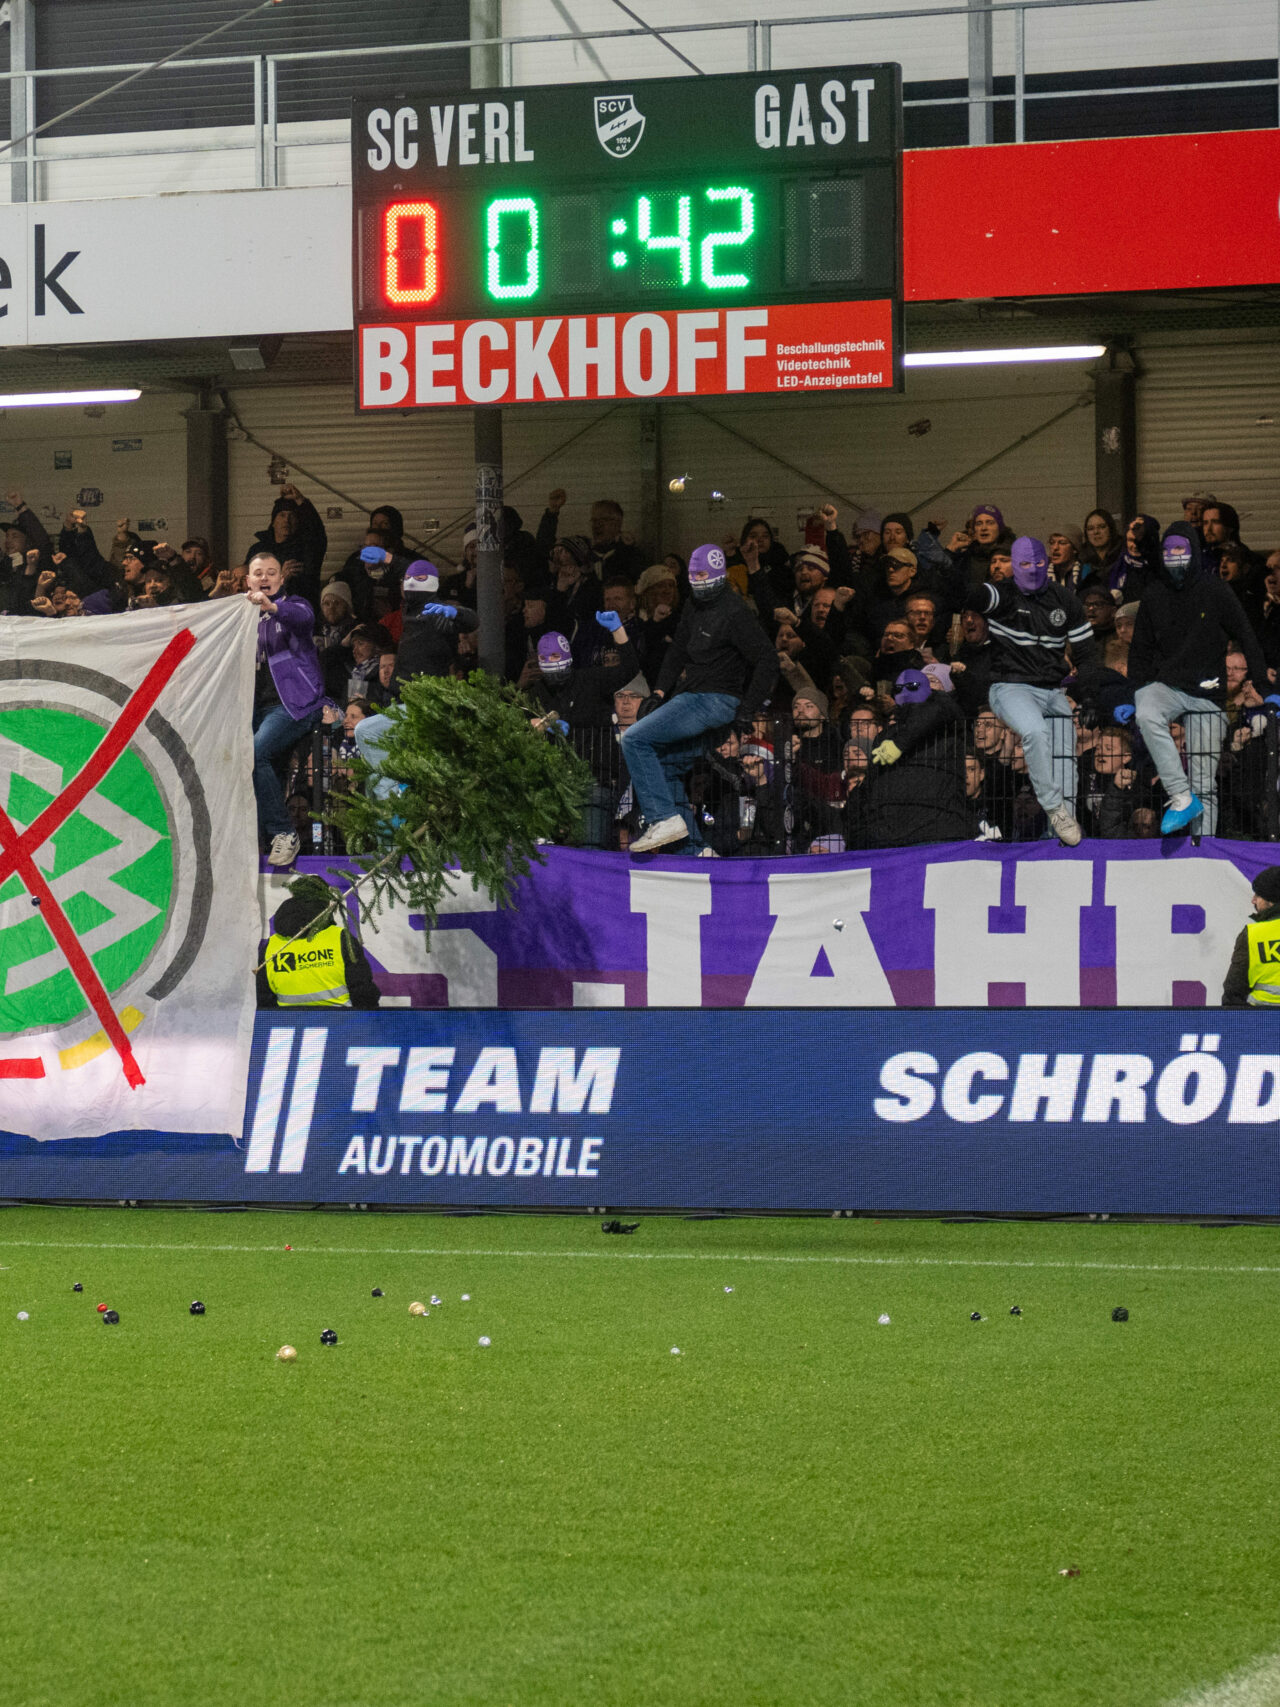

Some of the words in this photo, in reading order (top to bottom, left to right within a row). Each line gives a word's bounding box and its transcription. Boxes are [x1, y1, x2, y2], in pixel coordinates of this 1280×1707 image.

[599, 101, 626, 113] SCV
[754, 79, 874, 149] GAST
[367, 107, 418, 171] SC
[430, 100, 534, 167] VERL
[385, 202, 437, 303] 0
[362, 309, 768, 406] BECKHOFF
[777, 340, 885, 355] Beschallungstechnik
[777, 357, 851, 371] Videotechnik
[777, 372, 883, 387] LED-Anzeigentafel
[299, 961, 334, 970] SICHERHEI
[345, 1047, 621, 1113] TEAM
[873, 1033, 1280, 1124] SCHRÖD
[337, 1136, 604, 1178] AUTOMOBILE
